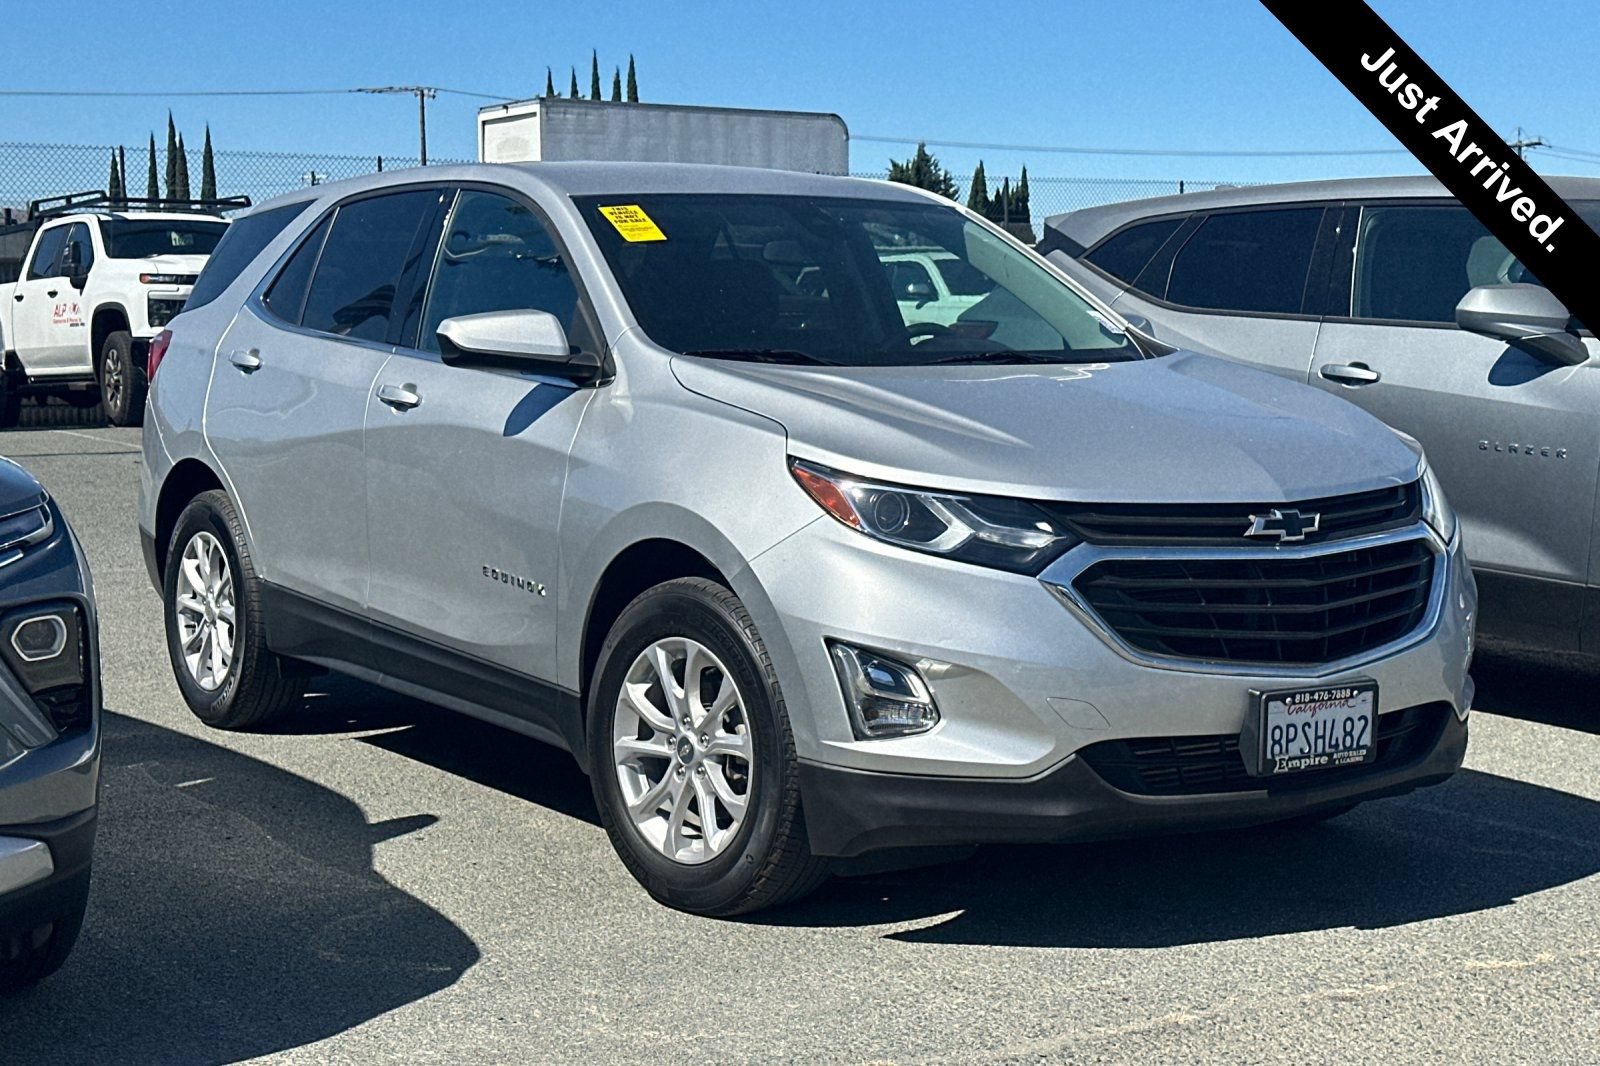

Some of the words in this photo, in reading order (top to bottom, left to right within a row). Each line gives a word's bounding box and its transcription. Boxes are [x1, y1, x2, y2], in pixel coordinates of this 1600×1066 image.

[1478, 439, 1567, 459] BLAZER
[482, 565, 546, 597] EQUINOX
[1270, 715, 1369, 758] 8PSH482
[1273, 755, 1329, 773] Empire
